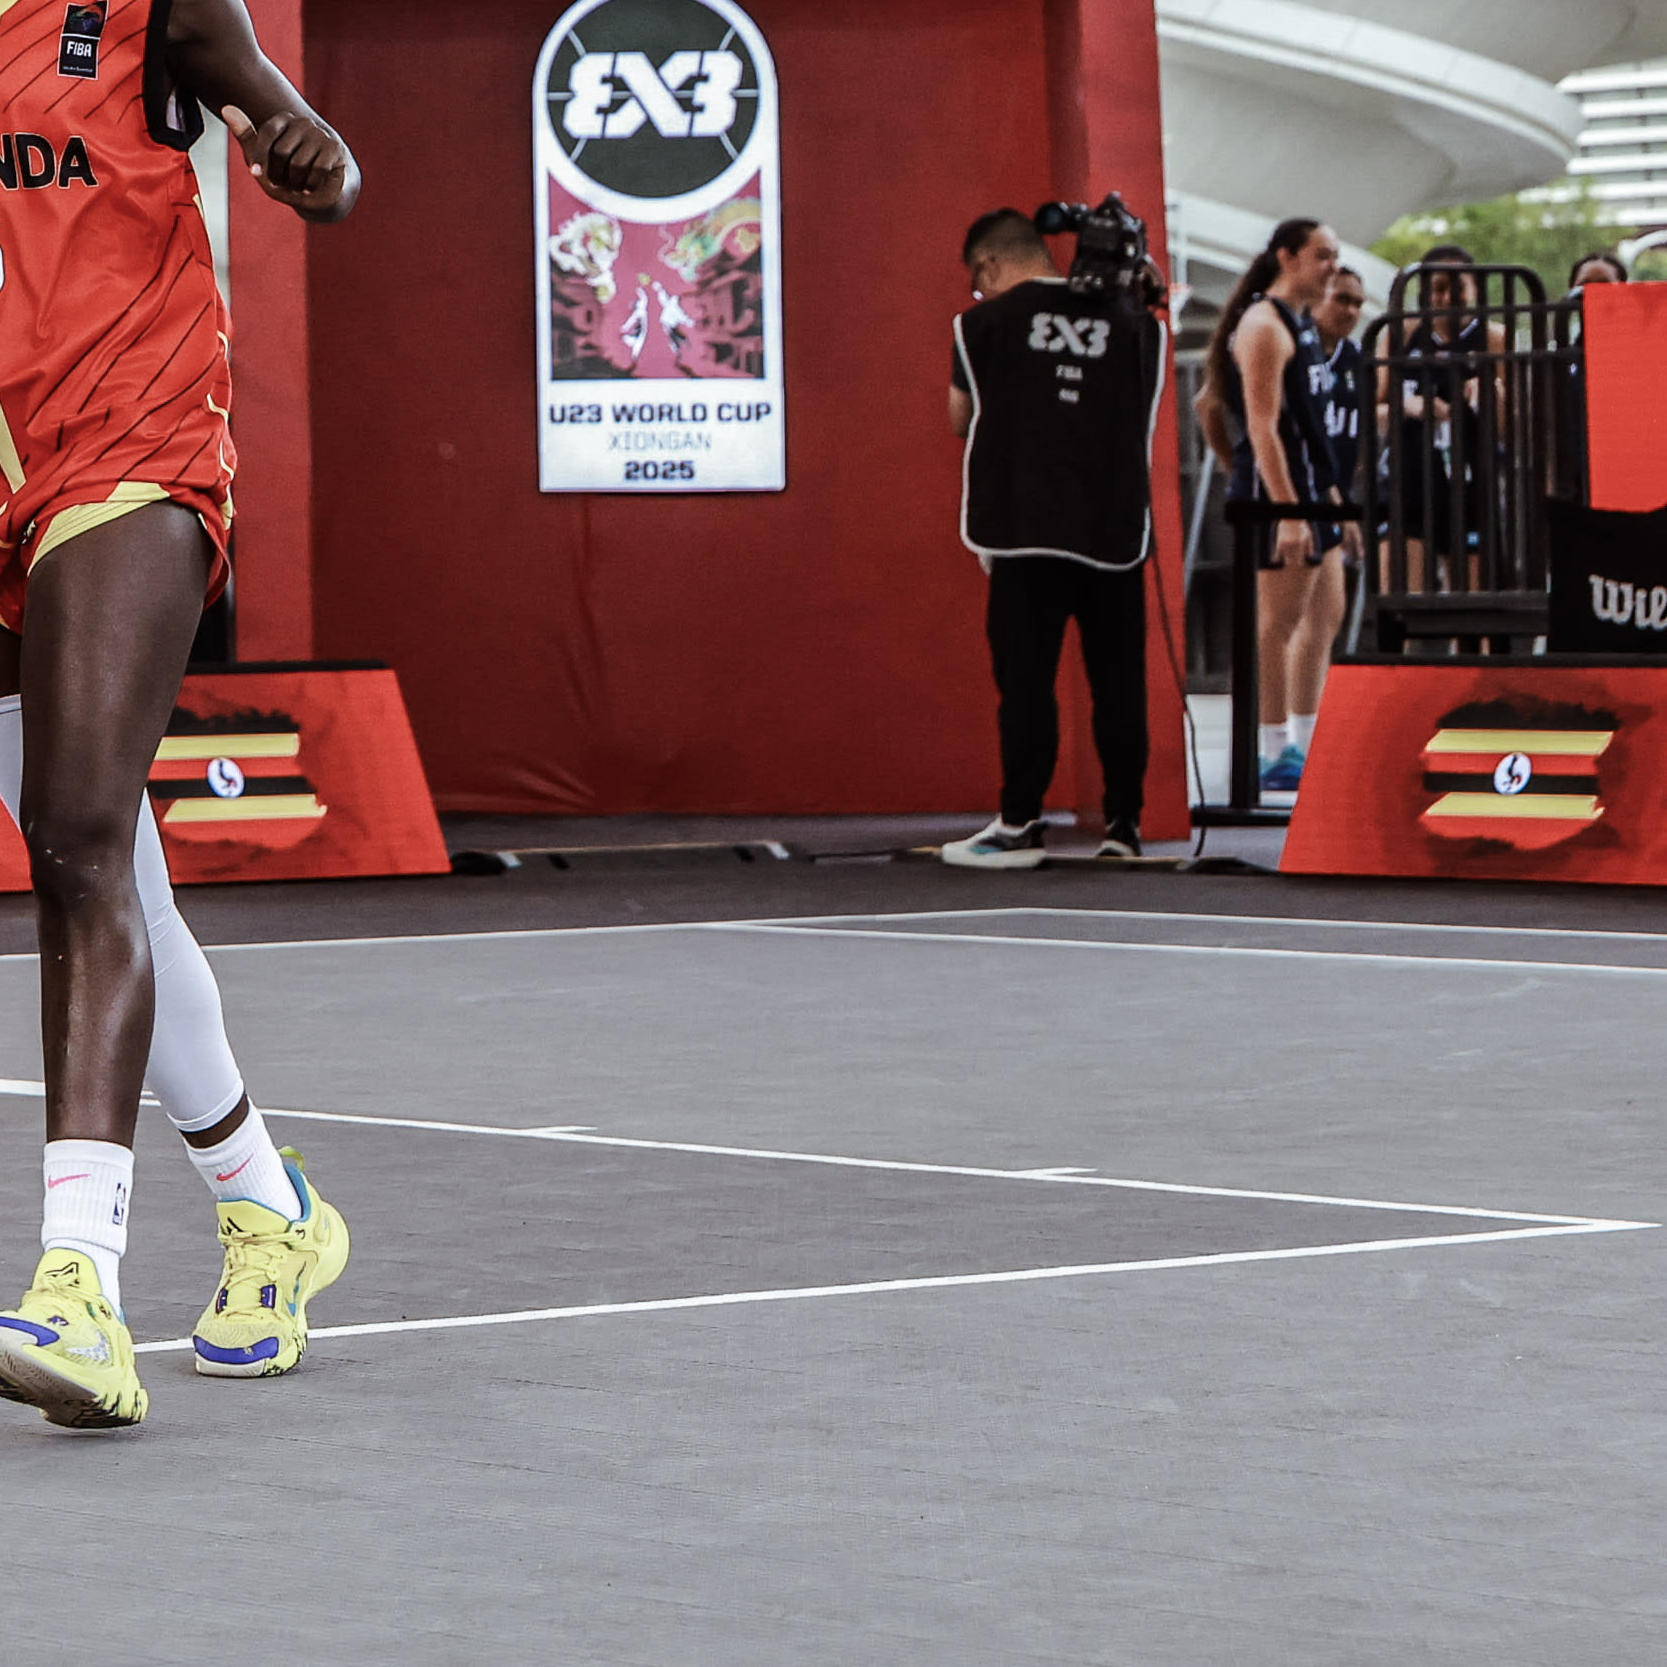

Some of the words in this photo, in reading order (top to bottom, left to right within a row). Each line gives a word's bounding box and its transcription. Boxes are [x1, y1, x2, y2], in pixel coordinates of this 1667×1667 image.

[66, 40, 93, 57] FIBA
[549, 403, 603, 424] U23
[611, 401, 708, 424] WORLD
[717, 400, 772, 423] CUP
[607, 431, 712, 452] XIONGAN
[623, 459, 695, 481] 2025
